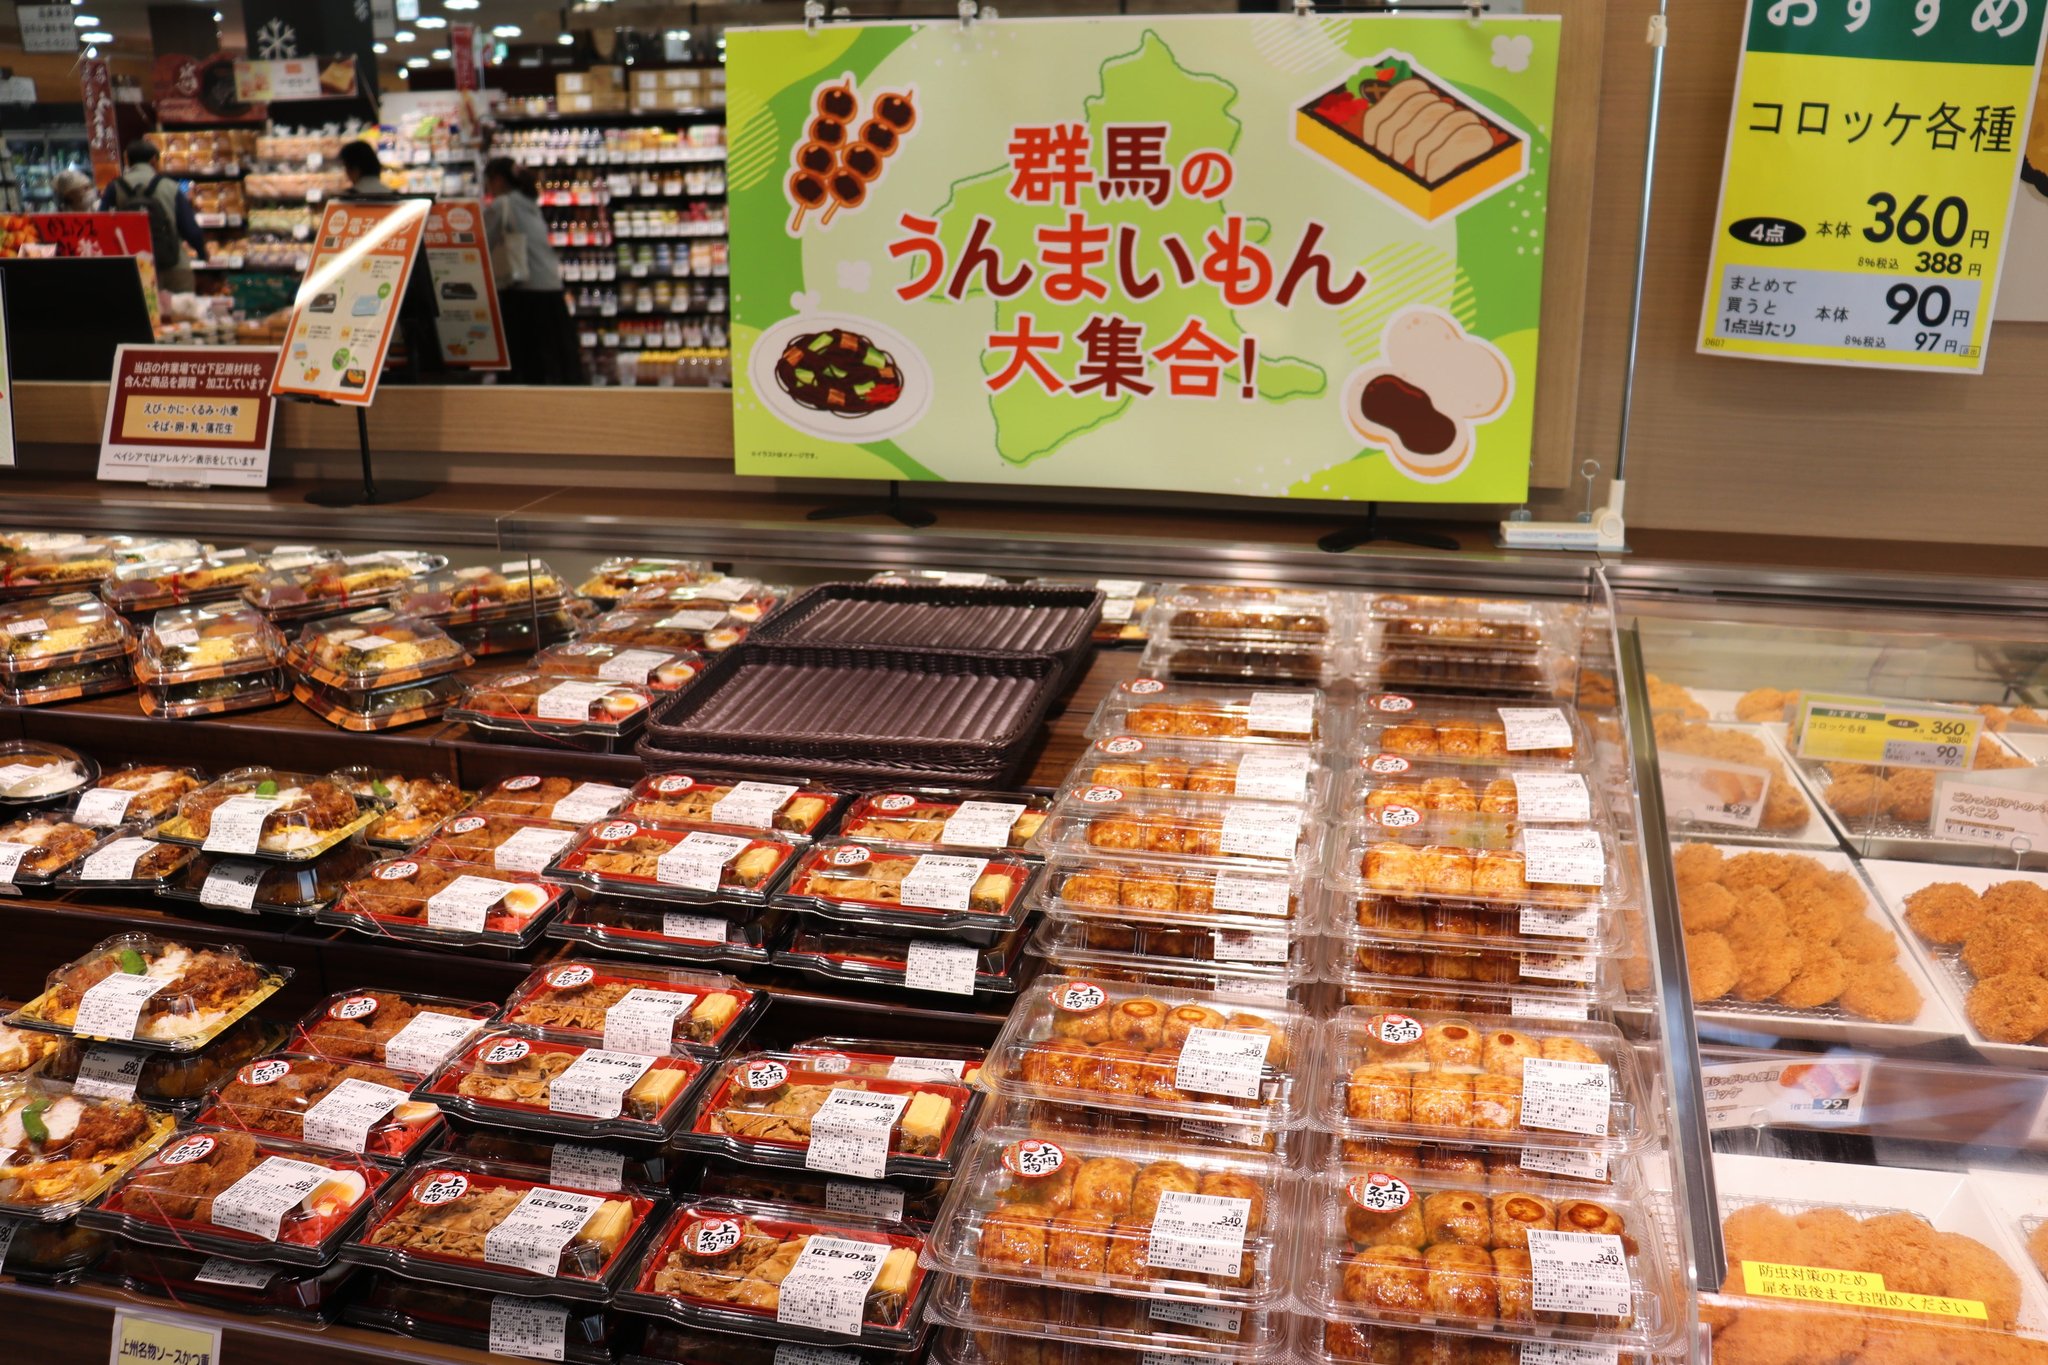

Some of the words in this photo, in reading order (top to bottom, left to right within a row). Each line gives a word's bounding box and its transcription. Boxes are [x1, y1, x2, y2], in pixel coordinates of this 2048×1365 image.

[1749, 101, 2016, 153] コロッケ各種
[1008, 124, 1234, 206] 群馬の
[1750, 223, 1786, 243] 4点
[1816, 221, 1852, 239] 本体
[886, 213, 1367, 306] うんまいもん
[1858, 256, 1899, 271] 8%税込
[1731, 275, 1797, 294] まとめて
[1727, 296, 1777, 315] 買うと
[1815, 306, 1850, 322] 本体
[1723, 318, 1797, 338] 1点当たり
[1844, 334, 1887, 348] 8%税込
[124, 1060, 139, 1073] 690
[529, 1198, 588, 1214] 広告の品
[561, 1219, 580, 1229] 499
[1222, 1215, 1242, 1225] 340
[811, 1248, 877, 1263] 広告の品
[1597, 1254, 1619, 1263] 340
[853, 1270, 872, 1280] 499
[1758, 1263, 1868, 1286] 防虫対策のため
